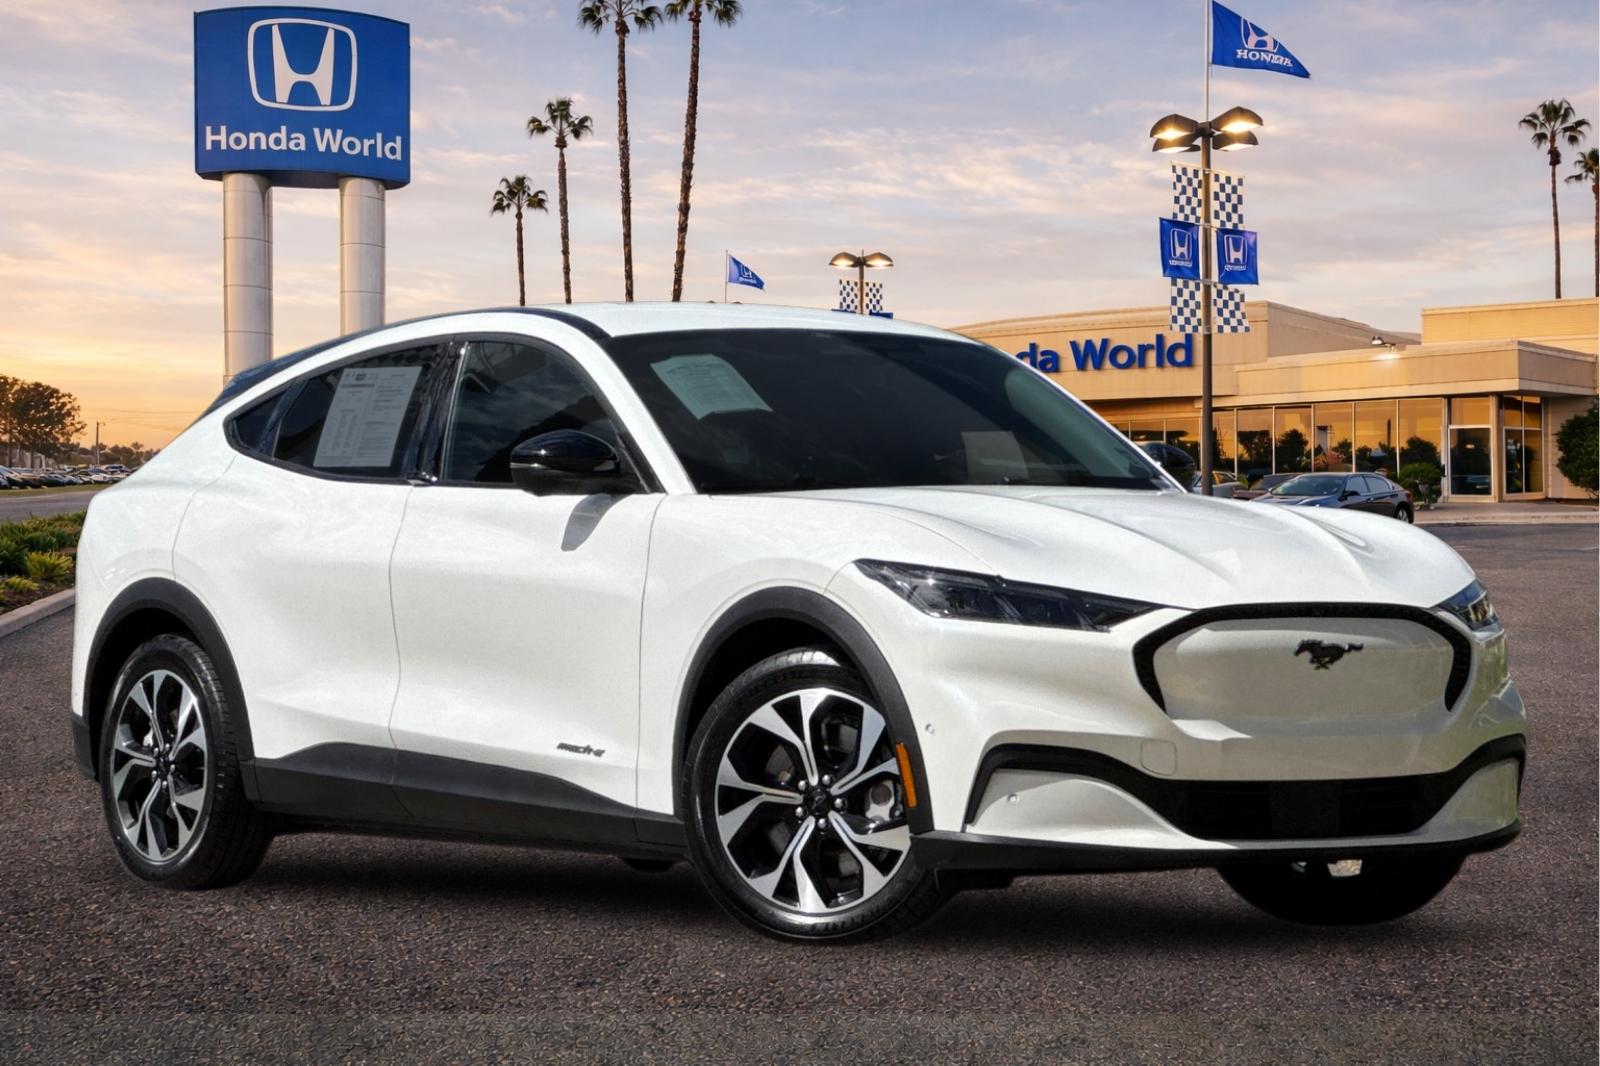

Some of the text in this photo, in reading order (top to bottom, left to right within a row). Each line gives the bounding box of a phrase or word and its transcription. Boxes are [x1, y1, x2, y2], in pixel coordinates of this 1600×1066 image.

[205, 125, 402, 161] Honda World
[1069, 333, 1194, 371] World
